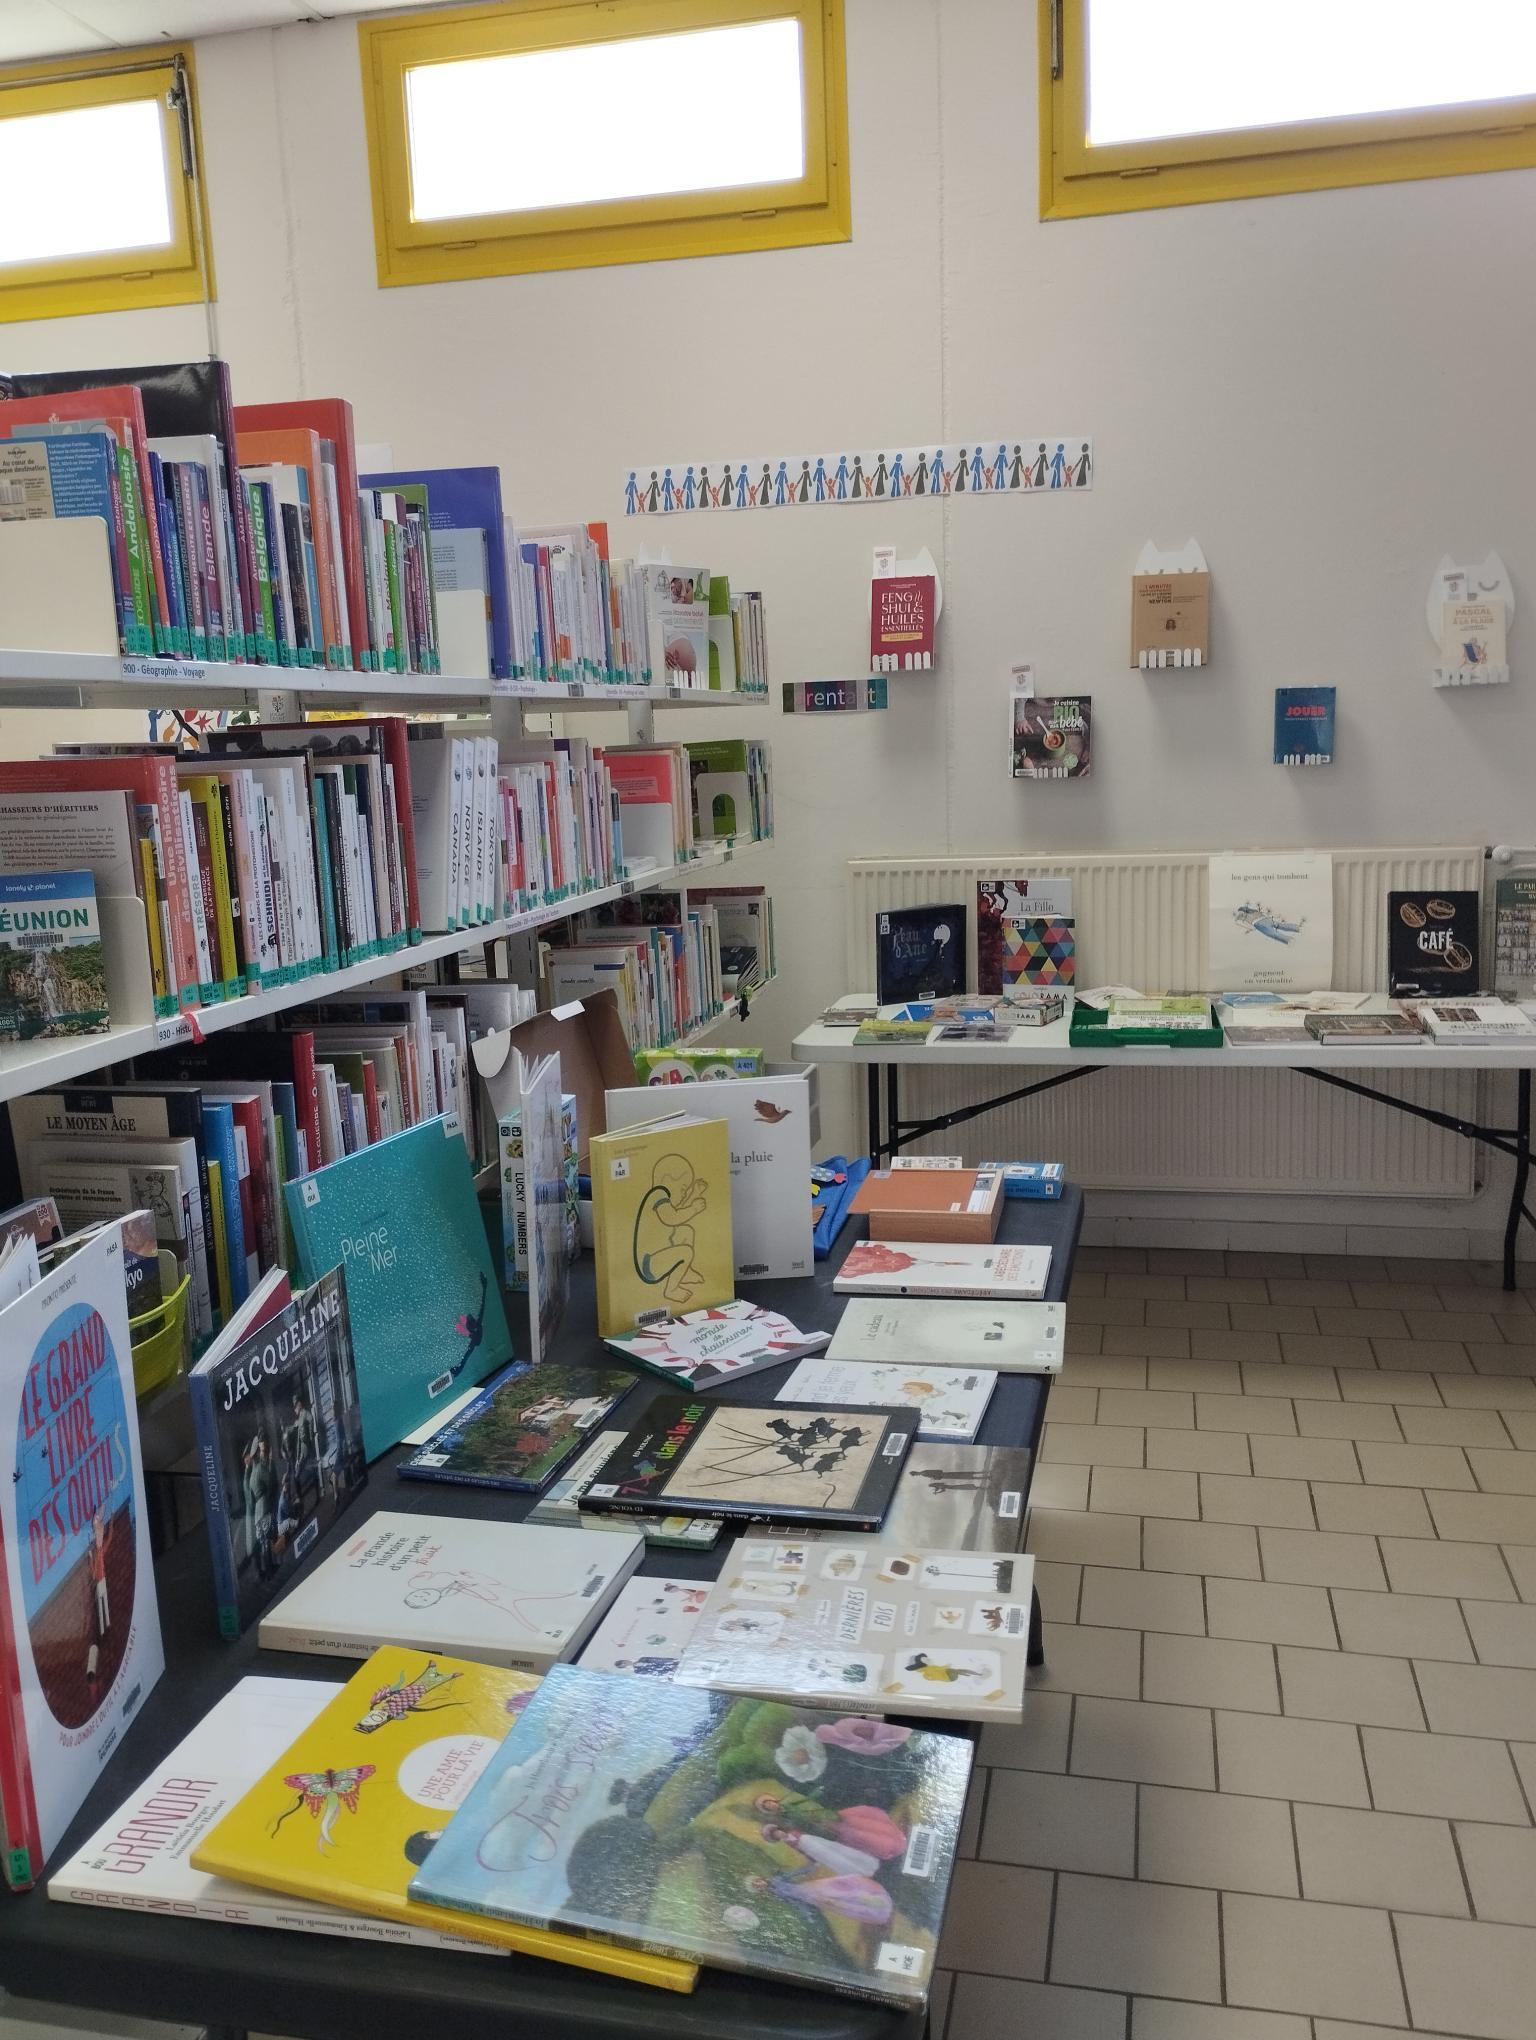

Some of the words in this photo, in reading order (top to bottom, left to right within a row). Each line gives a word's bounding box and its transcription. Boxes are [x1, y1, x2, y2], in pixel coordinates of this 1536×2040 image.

[122, 453, 140, 558] Andalousie
[234, 466, 246, 543] AMSTERDAM
[202, 506, 216, 582] Islande
[252, 490, 268, 582] Belgique
[881, 603, 911, 614] SHUI
[882, 592, 912, 604] FENG
[881, 614, 924, 626] HUILES
[122, 664, 136, 674] 900
[142, 664, 178, 677] Géographie
[183, 666, 206, 679] Voyage
[0, 806, 43, 814] HASSEURS
[160, 765, 173, 844] histoire
[170, 764, 188, 882] civilisations
[167, 847, 178, 886] Une
[248, 830, 259, 880] PROTOHISTOIRE
[451, 812, 462, 885] CANADA
[1231, 872, 1241, 880] les
[1262, 873, 1275, 882] qui
[1276, 872, 1308, 880] tombent
[0, 908, 89, 932] ÉUNION
[178, 888, 192, 923] des
[190, 874, 205, 932] TRÉSORS
[1020, 901, 1032, 912] La
[1420, 928, 1454, 950] CAFÉ
[1253, 970, 1284, 978] gagnent
[1255, 976, 1294, 985] verticalité
[159, 1028, 171, 1041] 930
[46, 1117, 62, 1130] LE
[66, 1118, 108, 1130] MOYEN
[110, 1116, 136, 1132] ÂGE
[731, 1152, 742, 1164] la
[744, 1150, 774, 1169] pluie
[516, 1172, 525, 1202] LUCKY
[340, 1226, 388, 1264] Pleine
[517, 1211, 527, 1255] NUMBERS
[126, 1268, 143, 1290] kyo
[370, 1246, 398, 1276] Mer
[224, 1289, 340, 1411] JACQUELINE
[22, 1362, 45, 1440] LE
[46, 1310, 106, 1413] GRAND
[46, 1387, 98, 1490] LIVRE
[656, 1434, 686, 1460] dans
[682, 1404, 706, 1424] noir
[203, 1445, 220, 1512] JACQUELINE
[29, 1491, 66, 1586] DES
[350, 1554, 366, 1570] La
[364, 1530, 394, 1559] grande
[371, 1536, 410, 1568] histoire
[389, 1549, 413, 1572] d'un
[408, 1534, 432, 1556] petit
[840, 1588, 865, 1641] DERNIÈRES
[874, 1604, 894, 1628] FOIS
[308, 1638, 326, 1649] petit
[418, 1776, 438, 1798] UNE
[434, 1747, 463, 1778] AMIE
[432, 1774, 456, 1801] POUR
[468, 1740, 485, 1758] VIE
[103, 1778, 218, 1874] GRANDIR
[70, 1889, 249, 1920] GRANDIR
